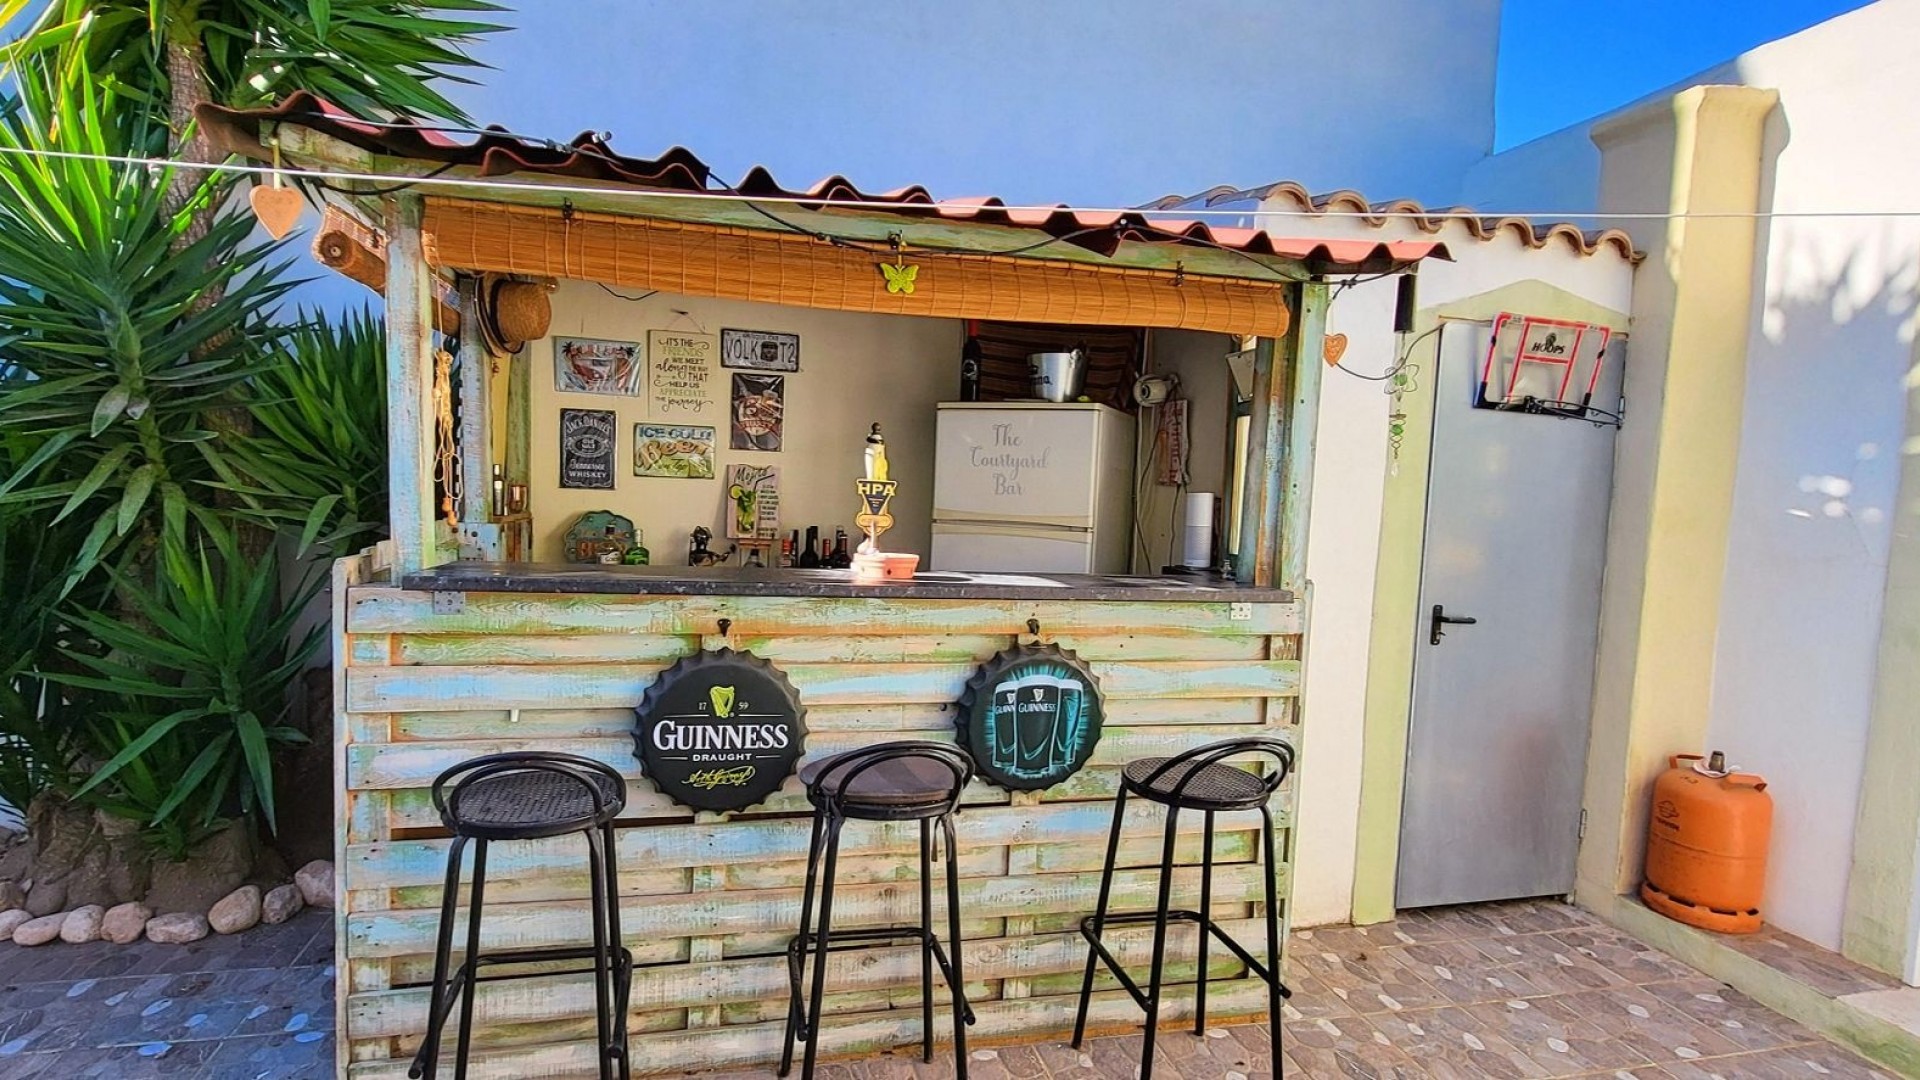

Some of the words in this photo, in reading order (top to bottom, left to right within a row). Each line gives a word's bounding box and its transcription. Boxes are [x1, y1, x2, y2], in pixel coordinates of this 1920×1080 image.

[726, 338, 758, 361] VOLK
[779, 341, 796, 364] T2
[1531, 342, 1565, 354] HOOPS
[685, 357, 705, 365] MEET
[655, 357, 687, 380] along
[688, 372, 710, 382] THAT
[669, 380, 688, 388] HELP
[689, 381, 700, 389] US
[661, 396, 714, 413] journey
[639, 427, 666, 438] ICE
[992, 423, 1021, 447] The
[969, 445, 1051, 481] Courtyard
[568, 470, 607, 478] WHISKEY
[733, 467, 768, 486] Mojito
[858, 482, 896, 496] HPA
[992, 472, 1024, 496] Bar
[698, 702, 707, 711] 17
[738, 701, 749, 711] 59
[1018, 702, 1057, 712] GUINNESS
[653, 720, 789, 751] GUINNESS
[692, 753, 752, 762] DRAUGHT
